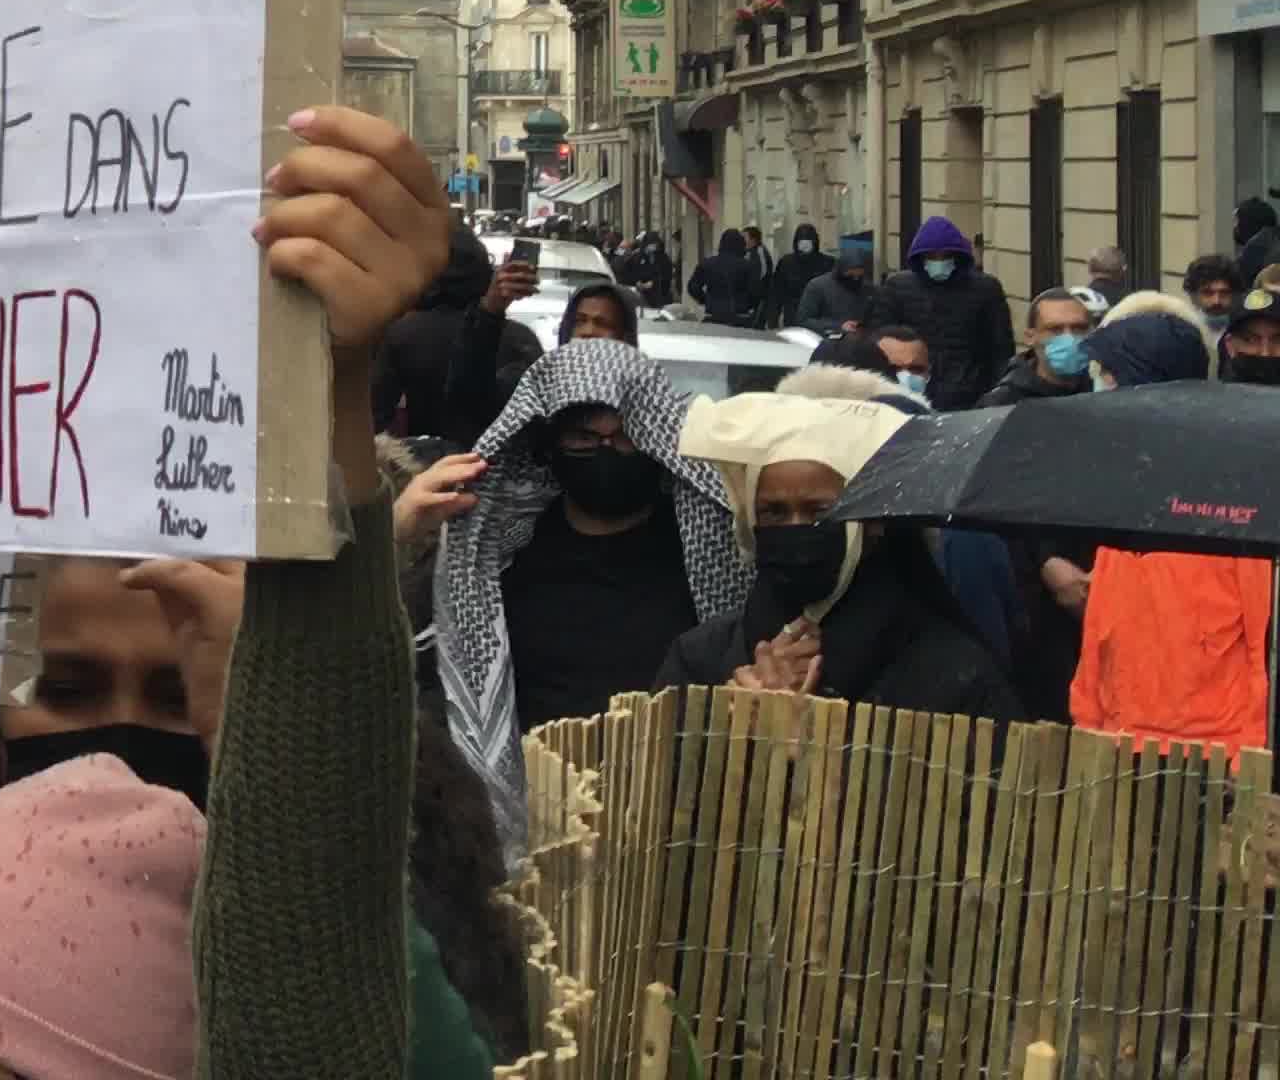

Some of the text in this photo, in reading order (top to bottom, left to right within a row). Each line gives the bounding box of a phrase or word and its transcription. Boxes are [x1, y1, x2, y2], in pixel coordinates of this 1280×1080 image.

[63, 97, 191, 220] DANS
[161, 347, 245, 427] Martin
[154, 424, 236, 494] Luther
